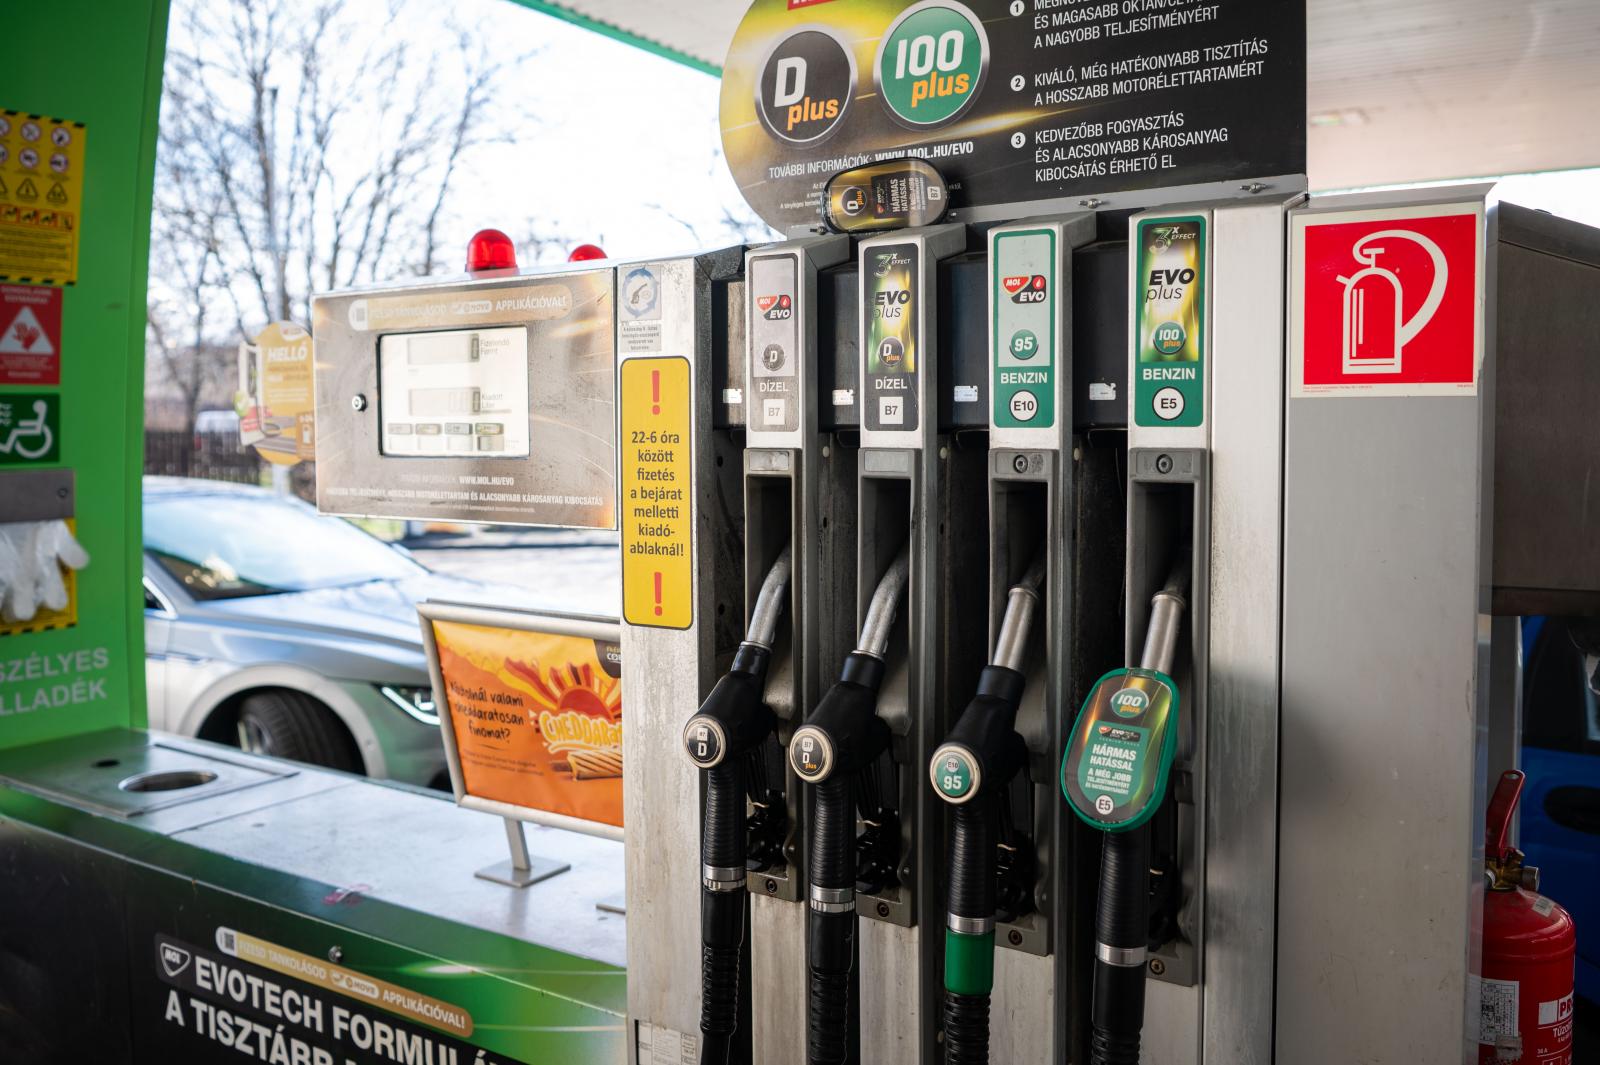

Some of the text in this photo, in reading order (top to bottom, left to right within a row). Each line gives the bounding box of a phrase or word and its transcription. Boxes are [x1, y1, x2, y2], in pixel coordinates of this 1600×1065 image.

[1034, 12, 1048, 30] ÉS
[1052, 3, 1118, 27] MAGASABB
[1034, 36, 1042, 48] A
[1046, 26, 1100, 47] NAGYOBB
[1104, 5, 1220, 37] TELJESÍTMÉNYÉRT
[895, 30, 965, 80] 100
[1034, 65, 1077, 87] KIVÁLÓ,
[1081, 61, 1107, 80] MÉG
[1111, 49, 1199, 75] HATÉKONYABB
[1203, 37, 1268, 62] TISZTÍTÁS
[774, 56, 807, 107] D
[1034, 60, 1264, 107] A HOSSZABB MOTORÉLETTARTAMÉRT
[911, 71, 971, 108] plus
[787, 96, 840, 131] plus
[1035, 122, 1103, 144] KEDVEZŐBB
[1106, 110, 1184, 135] FOGYASZTÁS
[1035, 127, 1228, 163] ÉS ALACSONYABB KÁROSANYAG
[769, 162, 805, 179] TOVÁBBI
[807, 155, 872, 175] INFORMÁCIÓK:
[1035, 152, 1176, 182] KIBOCSÁTÁS ÉRHETŐ EL
[847, 200, 859, 210] D
[856, 191, 864, 205] plus
[1006, 278, 1021, 287] MOL
[1149, 268, 1195, 286] EVO
[875, 290, 911, 306] EVO
[1019, 291, 1045, 302] EVO
[1146, 284, 1182, 303] plus
[769, 310, 790, 319] EVO
[873, 304, 901, 320] plus
[1159, 329, 1180, 341] 100
[883, 343, 892, 357] D
[1014, 337, 1033, 352] 95
[1163, 339, 1181, 349] plus
[770, 351, 778, 363] D
[886, 354, 901, 362] plus
[1001, 372, 1048, 384] BENZIN
[1143, 367, 1196, 381] BENZIN
[759, 380, 789, 392] DÍZEL
[875, 377, 907, 390] DÍZEL
[884, 405, 898, 416] B7
[1013, 400, 1034, 411] E10
[1160, 398, 1177, 409] E5
[768, 407, 781, 417] B7
[631, 430, 680, 444] 22-6 óra
[637, 449, 673, 463] között
[636, 467, 675, 482] fizetés
[630, 486, 682, 503] a bejárat
[633, 505, 679, 519] melletti
[638, 523, 676, 537] kiadó-
[629, 542, 684, 557] ablaknál!
[490, 693, 524, 708] valami
[1117, 694, 1142, 708] 100
[468, 721, 511, 743] finomat?
[697, 742, 707, 756] D
[1092, 744, 1137, 761] HÁRMAS
[803, 752, 810, 763] D
[1090, 755, 1134, 772] HATÁSSAL
[1088, 768, 1094, 776] A
[1095, 769, 1111, 779] MÉG
[943, 775, 962, 790] 95
[1099, 799, 1111, 811] E5
[195, 955, 324, 1033] EVOTECH
[165, 989, 185, 1027] A
[383, 989, 466, 1029] APPLIKÁCIÓVAL!
